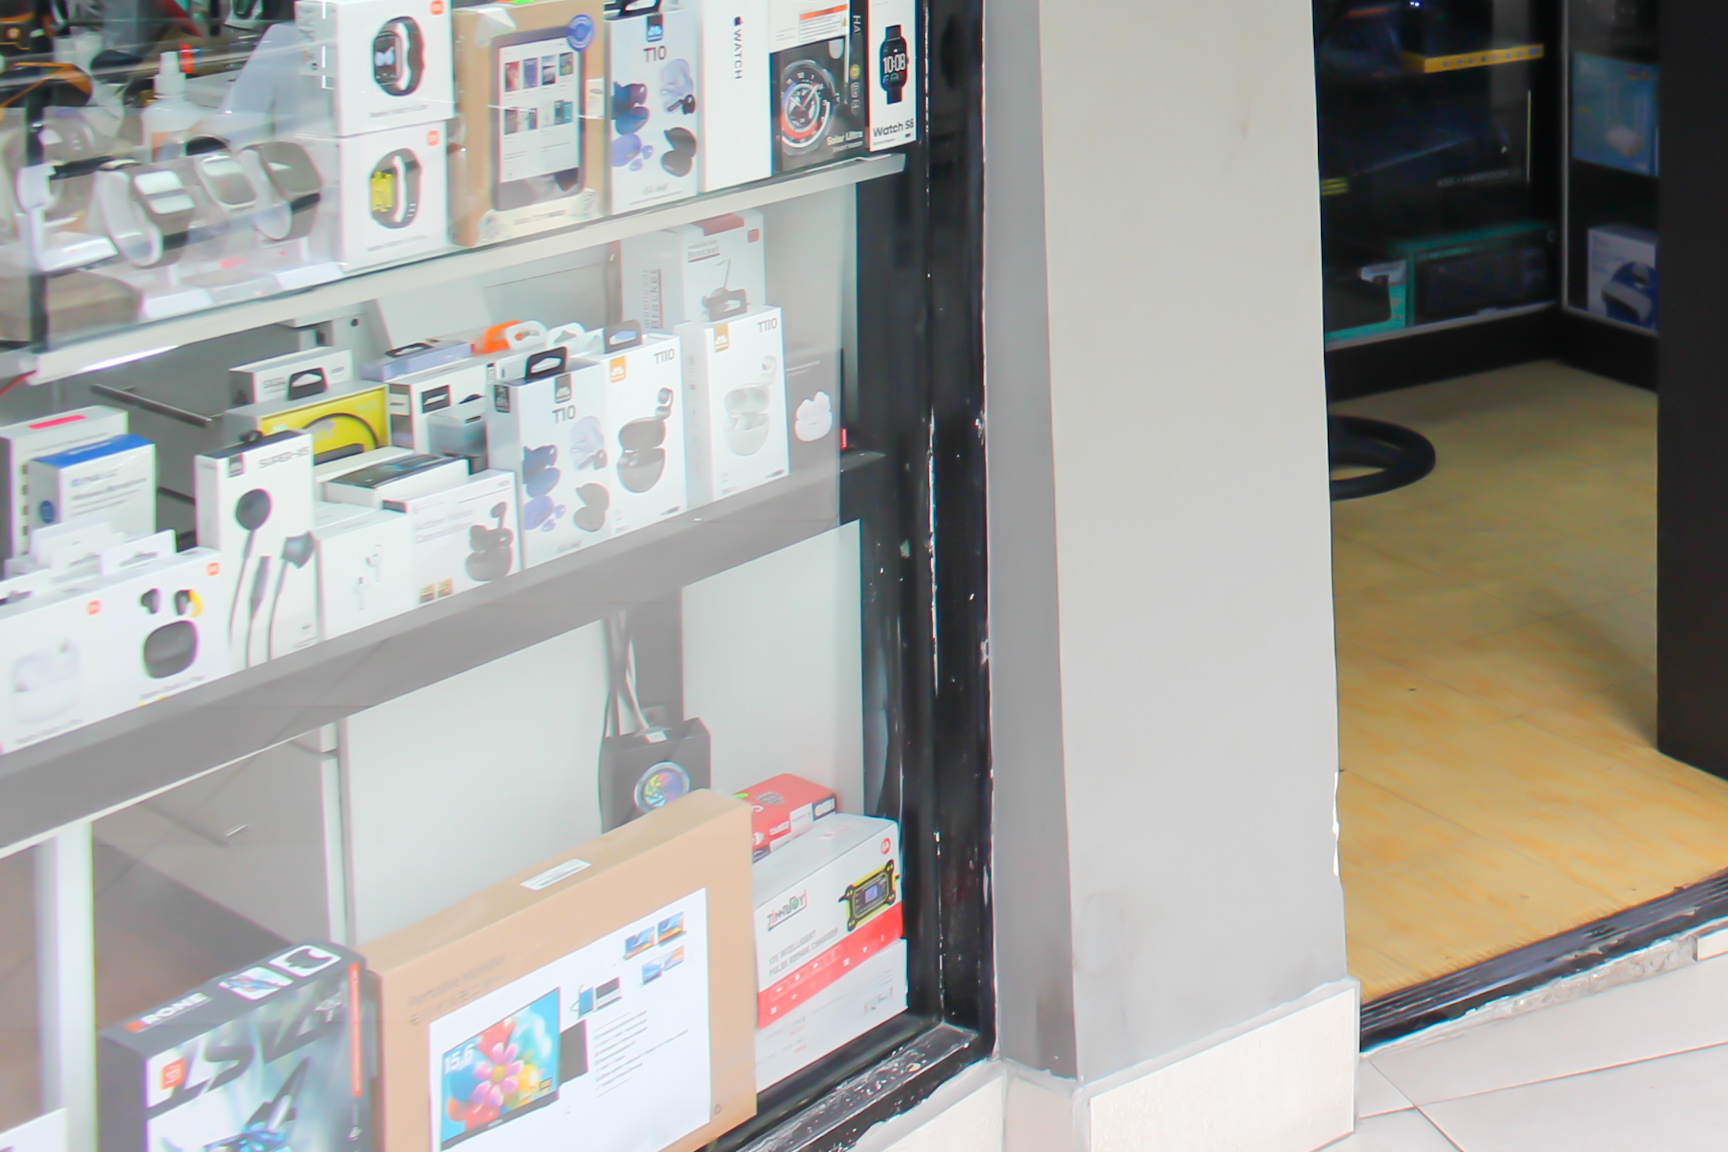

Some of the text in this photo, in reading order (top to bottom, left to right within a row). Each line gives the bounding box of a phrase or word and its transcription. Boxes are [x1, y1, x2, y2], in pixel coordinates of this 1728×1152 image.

[734, 28, 743, 79] WATCH
[882, 53, 907, 75] 10:08
[873, 120, 904, 137] Watch
[444, 1043, 475, 1074] 15.6
